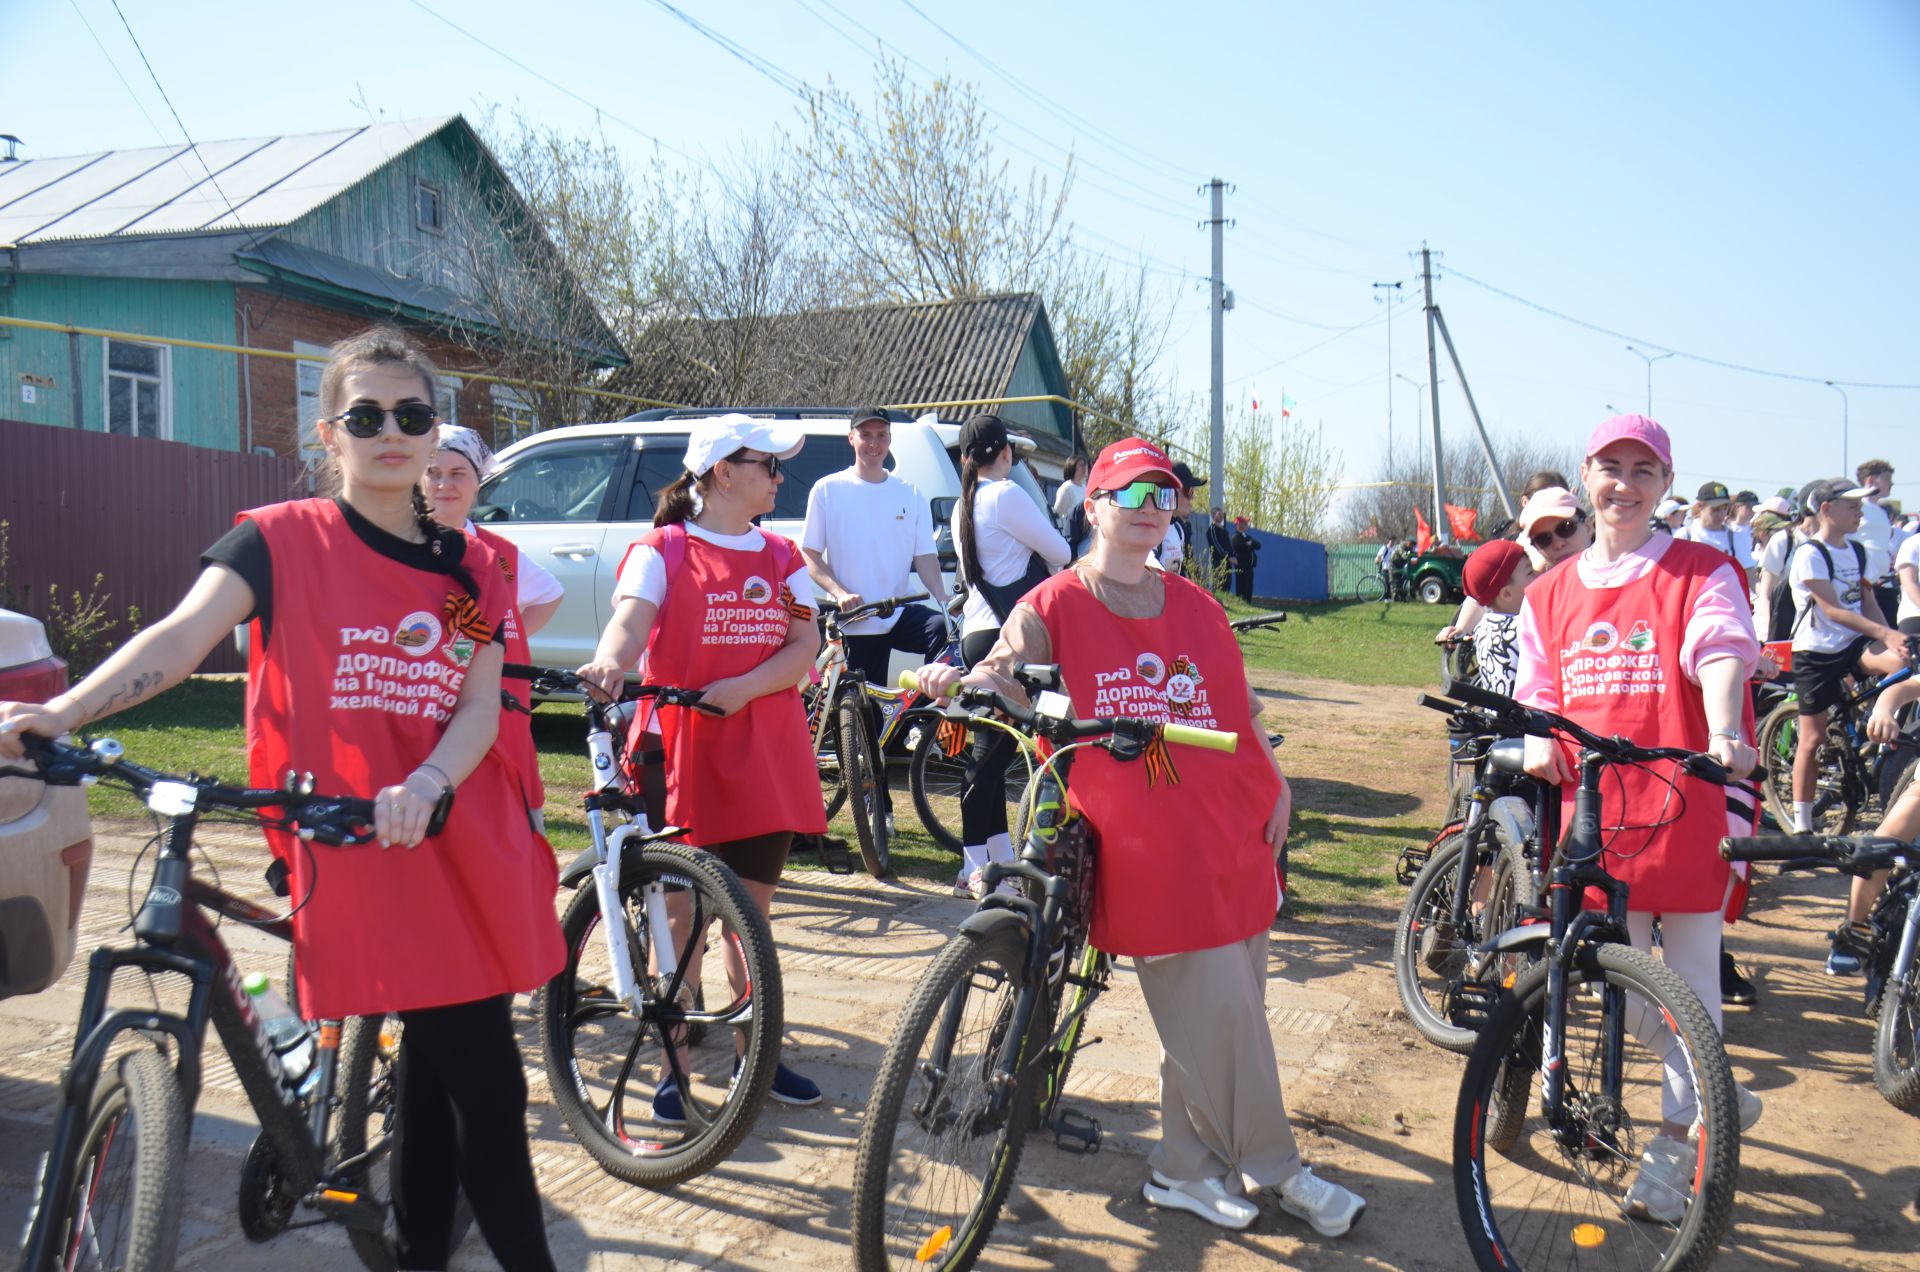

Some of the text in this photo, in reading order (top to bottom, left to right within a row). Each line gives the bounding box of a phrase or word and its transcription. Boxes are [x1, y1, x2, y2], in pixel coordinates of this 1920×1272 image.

[703, 623, 719, 633] на
[701, 633, 765, 646] железной
[333, 677, 360, 691] на
[1609, 683, 1666, 696] дороге
[1095, 705, 1115, 717] на
[255, 1023, 296, 1107] WOLF
